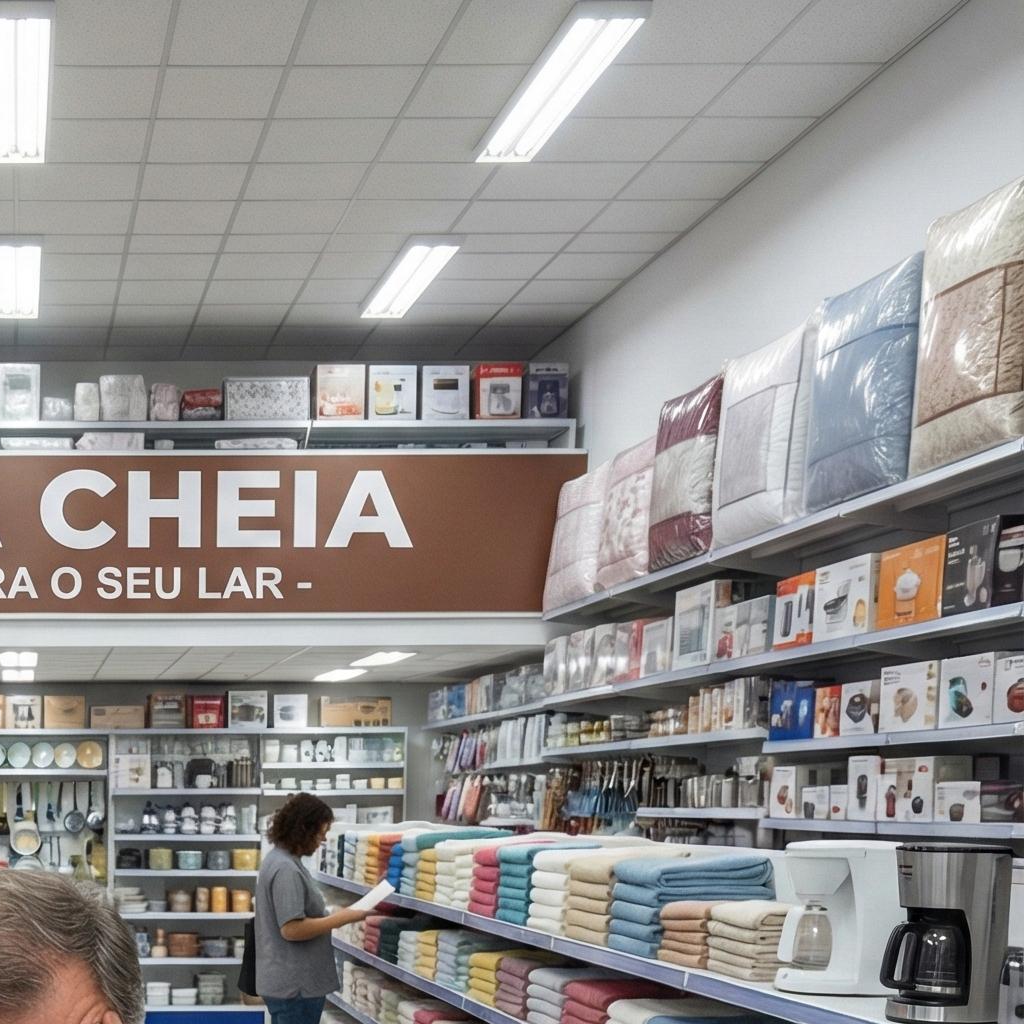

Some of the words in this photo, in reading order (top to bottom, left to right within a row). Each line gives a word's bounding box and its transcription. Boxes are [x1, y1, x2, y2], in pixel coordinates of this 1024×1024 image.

[40, 469, 414, 550] CHEIA
[51, 566, 83, 600] O
[97, 566, 181, 600] SEU
[198, 566, 284, 600] LAR
